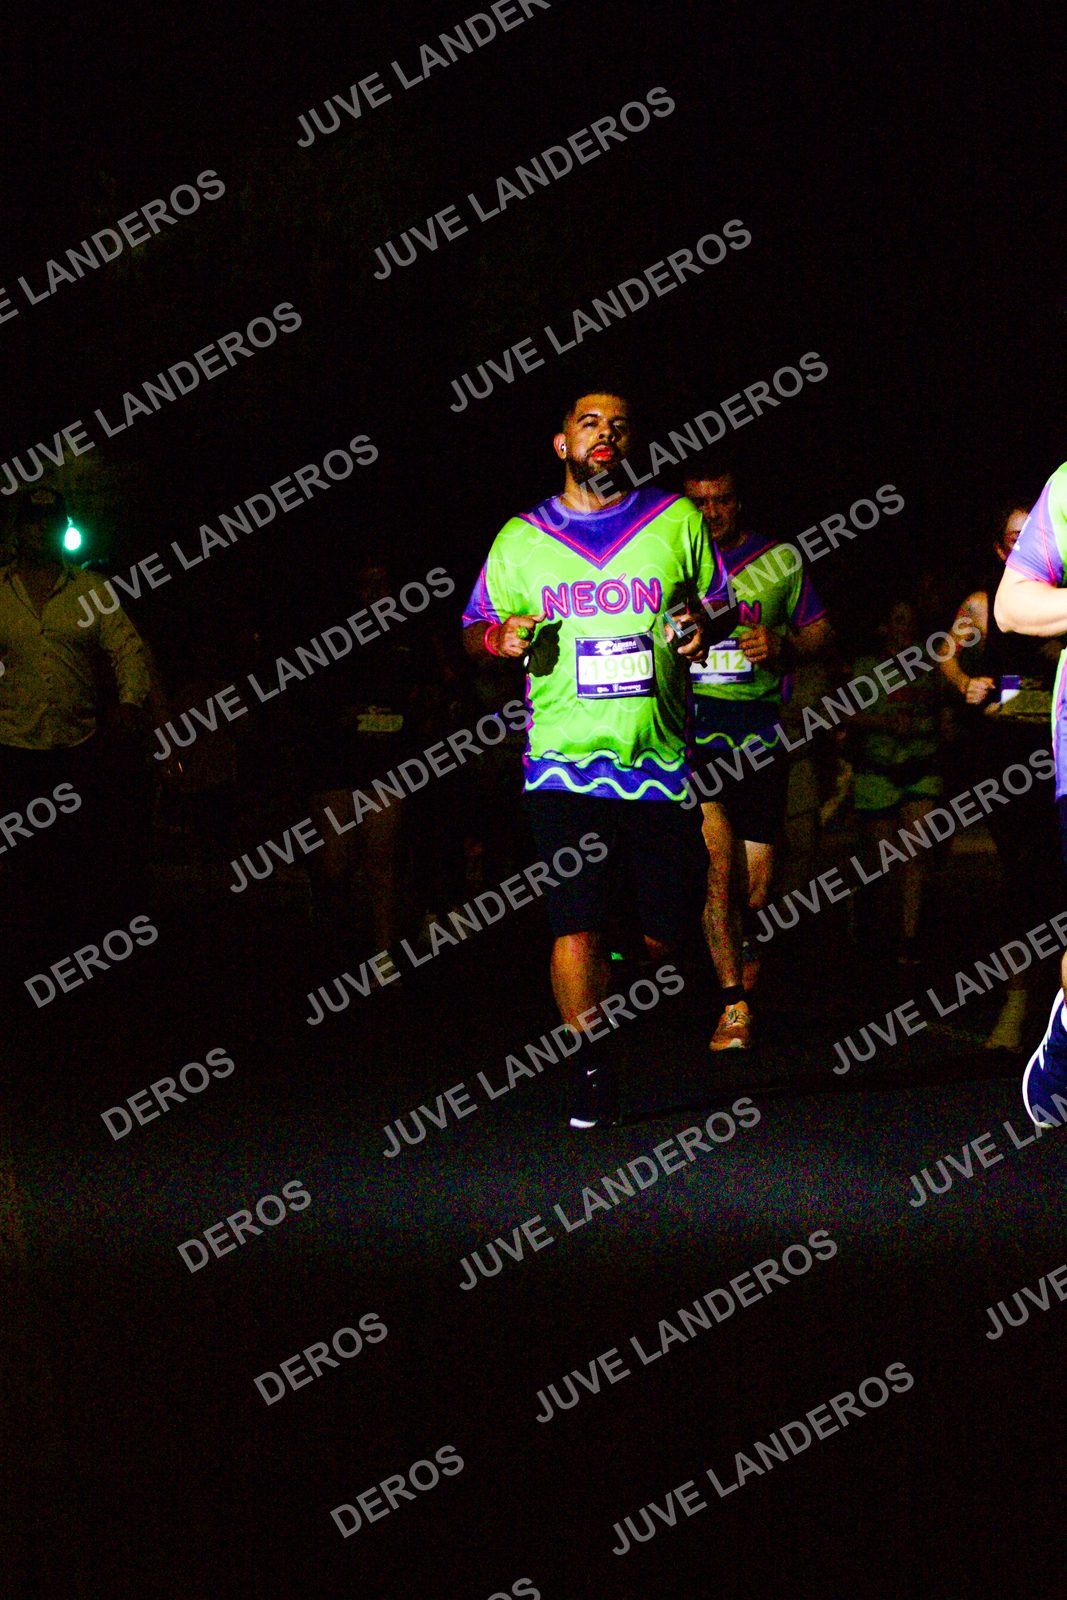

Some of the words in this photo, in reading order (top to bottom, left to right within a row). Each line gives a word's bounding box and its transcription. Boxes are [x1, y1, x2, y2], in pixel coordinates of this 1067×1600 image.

[542, 573, 662, 621] NEÓN
[591, 652, 650, 680] 1990
[704, 650, 746, 671] 112
